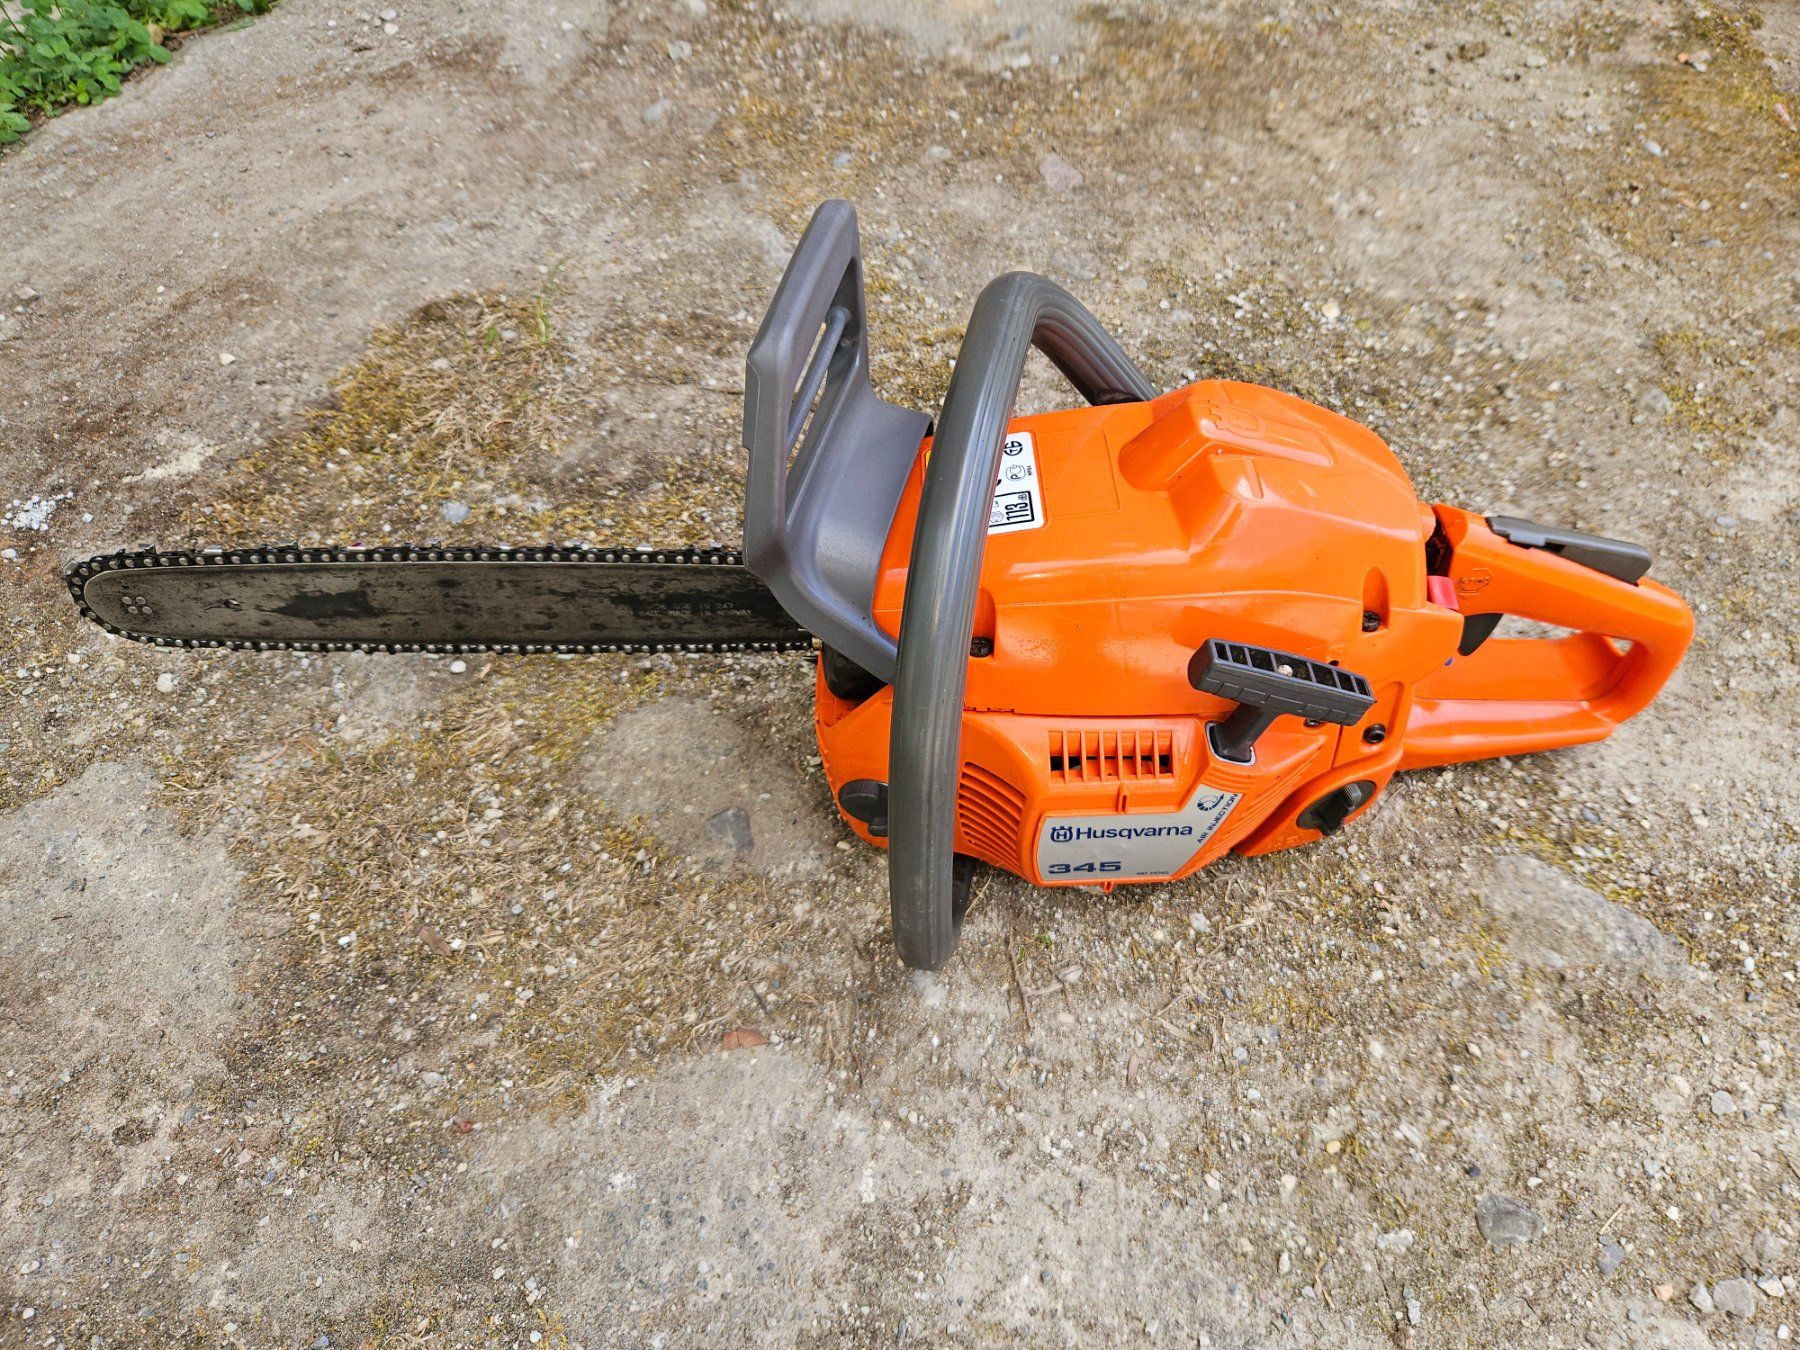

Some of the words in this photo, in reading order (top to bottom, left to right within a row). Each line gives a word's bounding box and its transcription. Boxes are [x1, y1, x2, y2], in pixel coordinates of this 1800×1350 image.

[1005, 502, 1029, 521] 113
[1197, 831, 1209, 844] AIR
[1207, 793, 1239, 831] INJECTION
[1076, 825, 1193, 841] Husqvarna
[1048, 861, 1122, 874] 345
